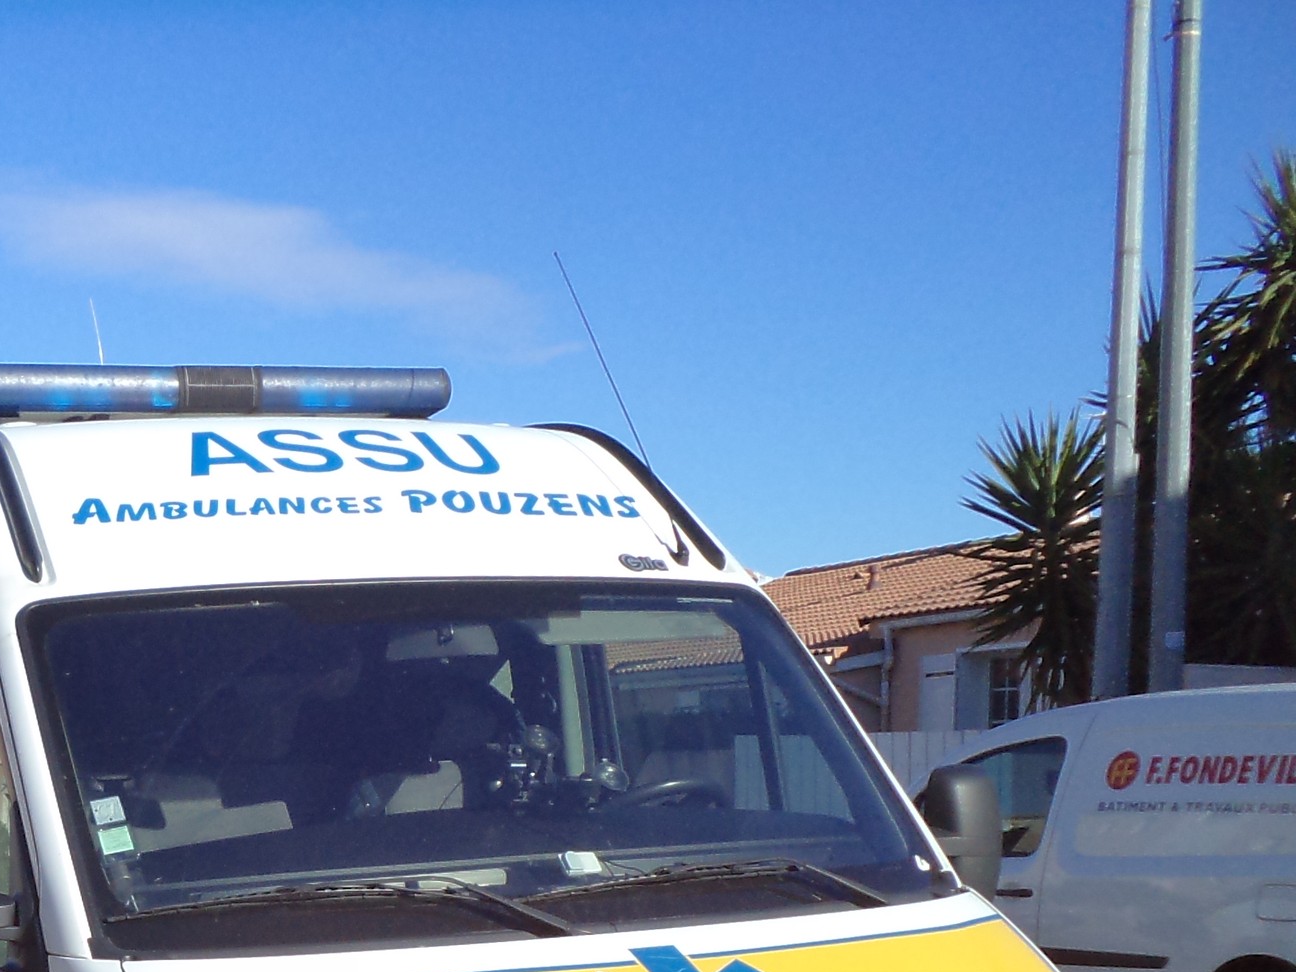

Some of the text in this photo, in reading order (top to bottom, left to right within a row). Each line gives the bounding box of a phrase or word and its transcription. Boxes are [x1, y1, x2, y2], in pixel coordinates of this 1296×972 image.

[190, 429, 501, 477] ASSU
[72, 489, 640, 526] AMBULANCES POUZENS
